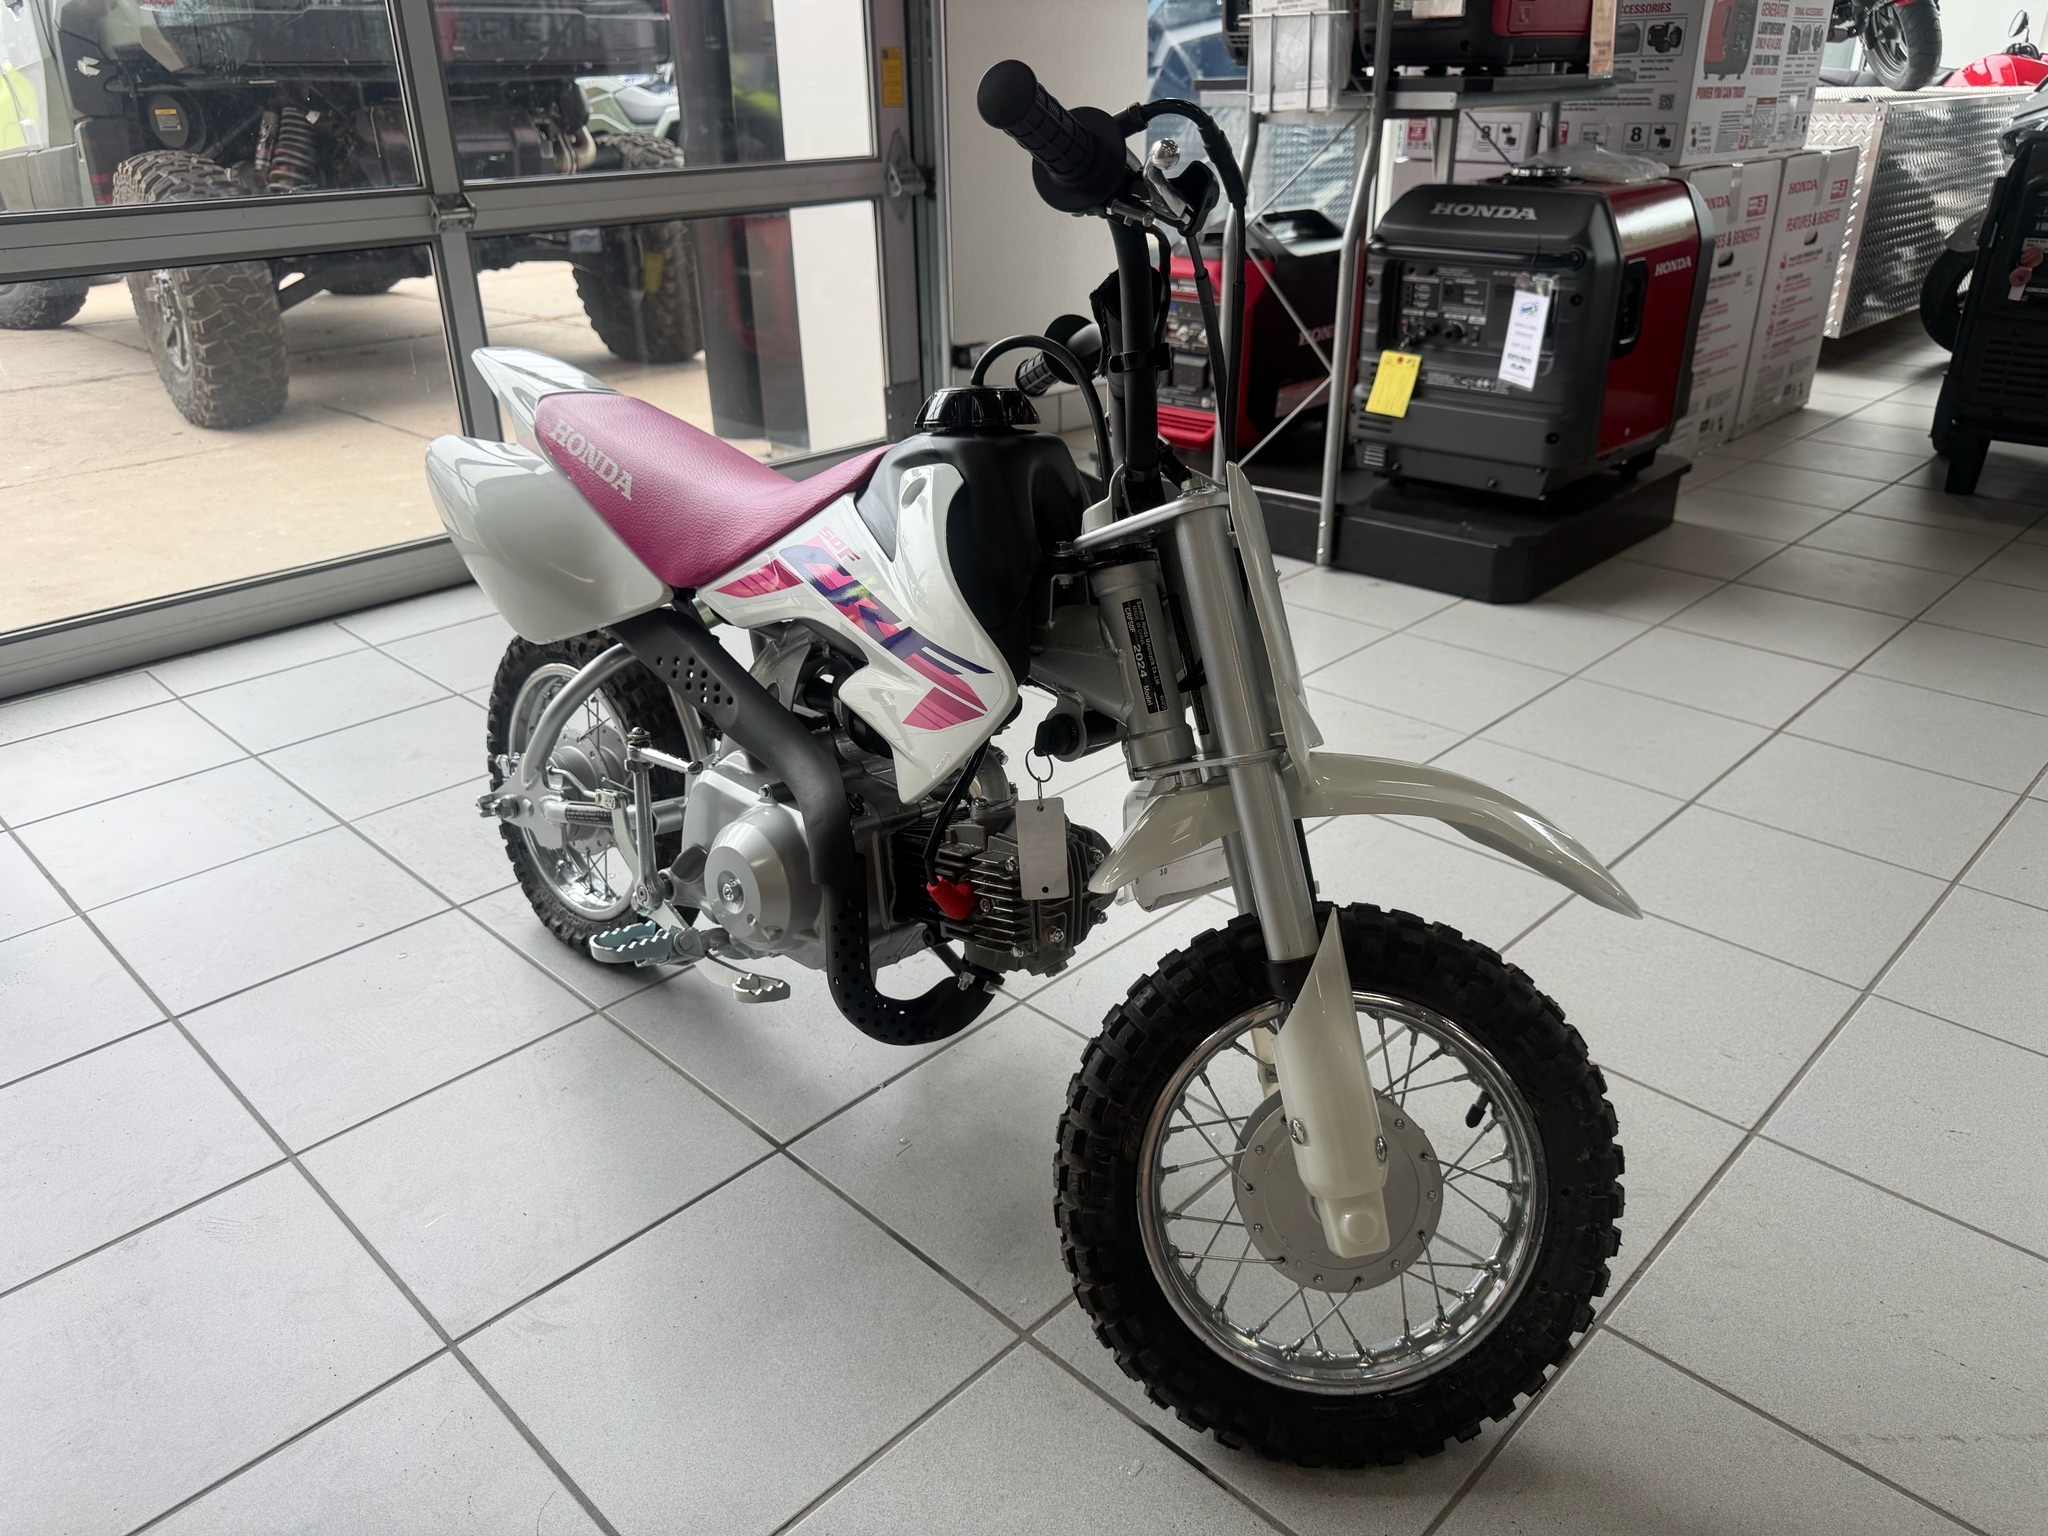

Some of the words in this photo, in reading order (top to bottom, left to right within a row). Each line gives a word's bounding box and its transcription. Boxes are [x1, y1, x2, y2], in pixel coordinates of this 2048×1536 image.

[1696, 87, 1714, 100] POWER
[1722, 87, 1732, 99] CAN
[1732, 86, 1746, 99] TRUST
[1630, 126, 1642, 142] 8
[1788, 179, 1818, 195] HONDA
[1430, 200, 1538, 222] HONDA
[1786, 213, 1813, 232] FEATURES
[1816, 208, 1841, 225] BENEFITS
[1732, 226, 1762, 246] BENEFITS
[1653, 255, 1692, 277] HONDA
[551, 419, 634, 502] HONDA
[818, 526, 861, 562] 50F
[1141, 621, 1150, 638] Honda
[1124, 607, 1136, 633] CRF50F
[1133, 644, 1148, 679] 2024
[1143, 684, 1154, 706] Model
[1145, 637, 1156, 666] Motorcycle
